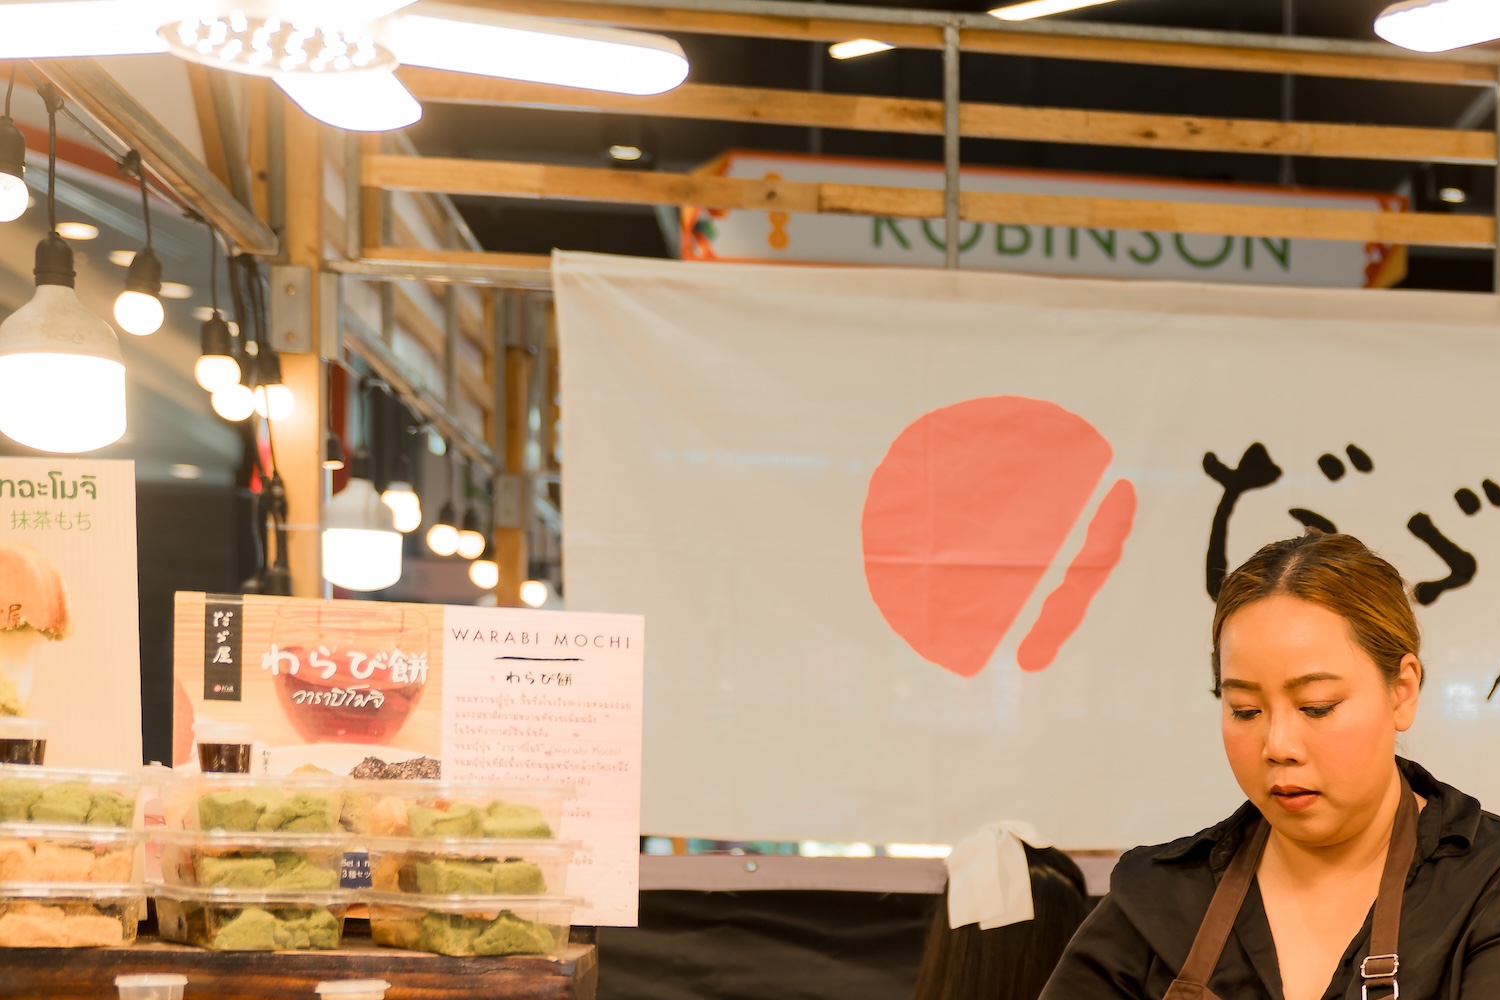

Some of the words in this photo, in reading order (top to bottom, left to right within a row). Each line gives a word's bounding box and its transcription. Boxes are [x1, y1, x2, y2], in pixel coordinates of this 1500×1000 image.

[0, 471, 98, 500] ทฉะโมจิ
[11, 509, 92, 531] 抹茶もち
[452, 628, 539, 645] WARABI
[554, 633, 630, 649] MOCHI
[261, 643, 429, 685] わらび餅
